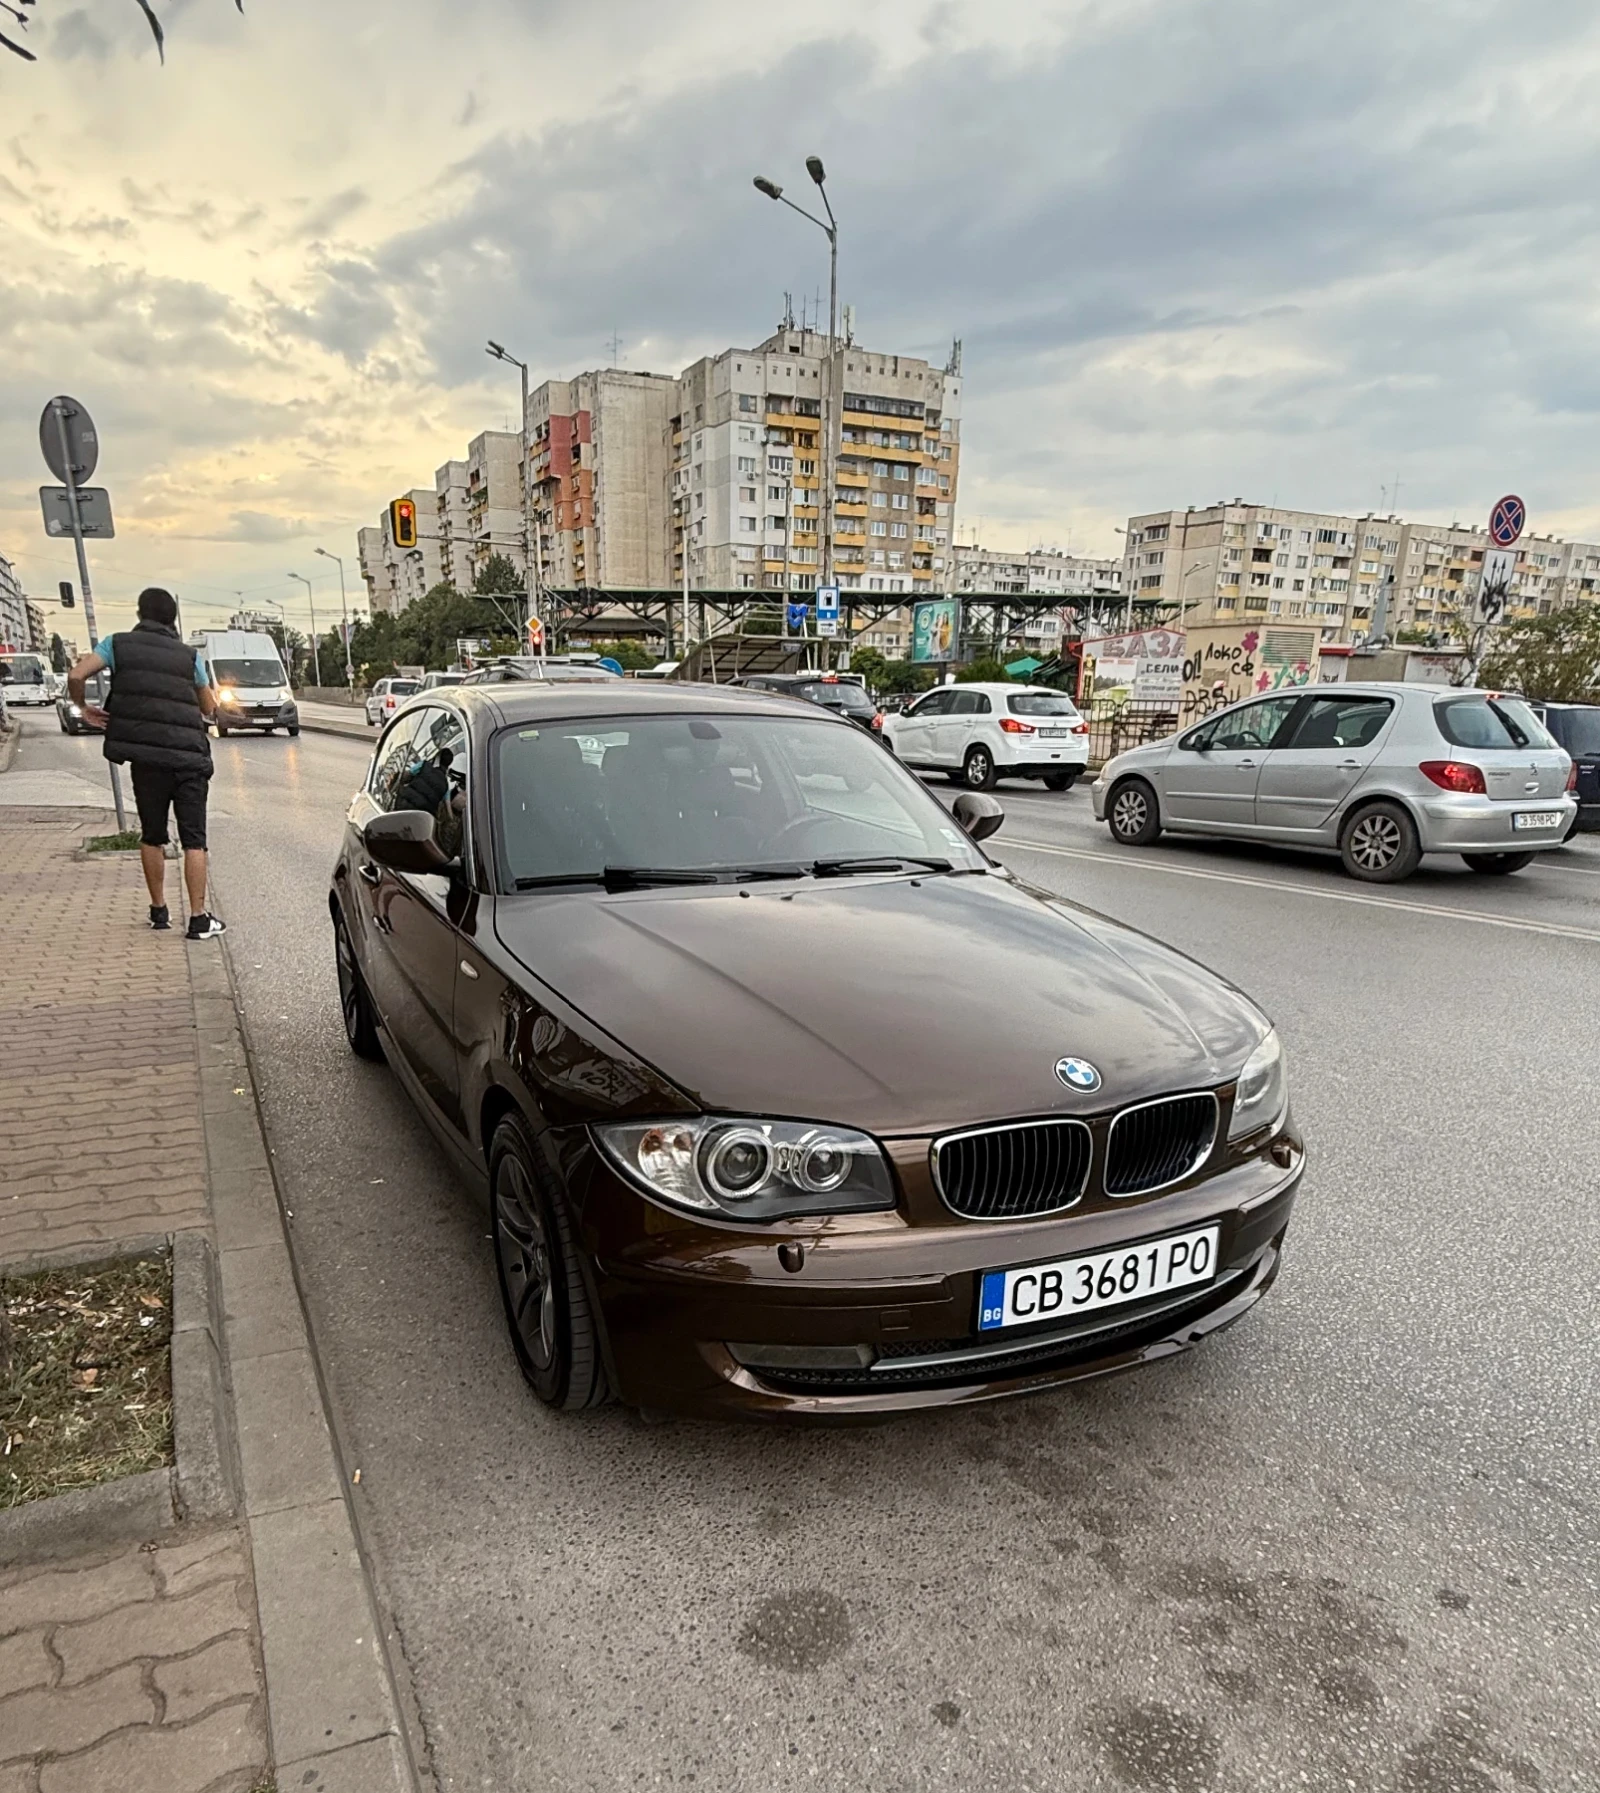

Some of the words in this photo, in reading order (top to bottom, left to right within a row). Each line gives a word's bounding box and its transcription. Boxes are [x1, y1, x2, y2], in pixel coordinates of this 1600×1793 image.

[1011, 1270, 1063, 1317] CB
[1071, 1248, 1159, 1306] 3681
[1166, 1236, 1210, 1284] PO
[983, 1307, 1002, 1323] BG
